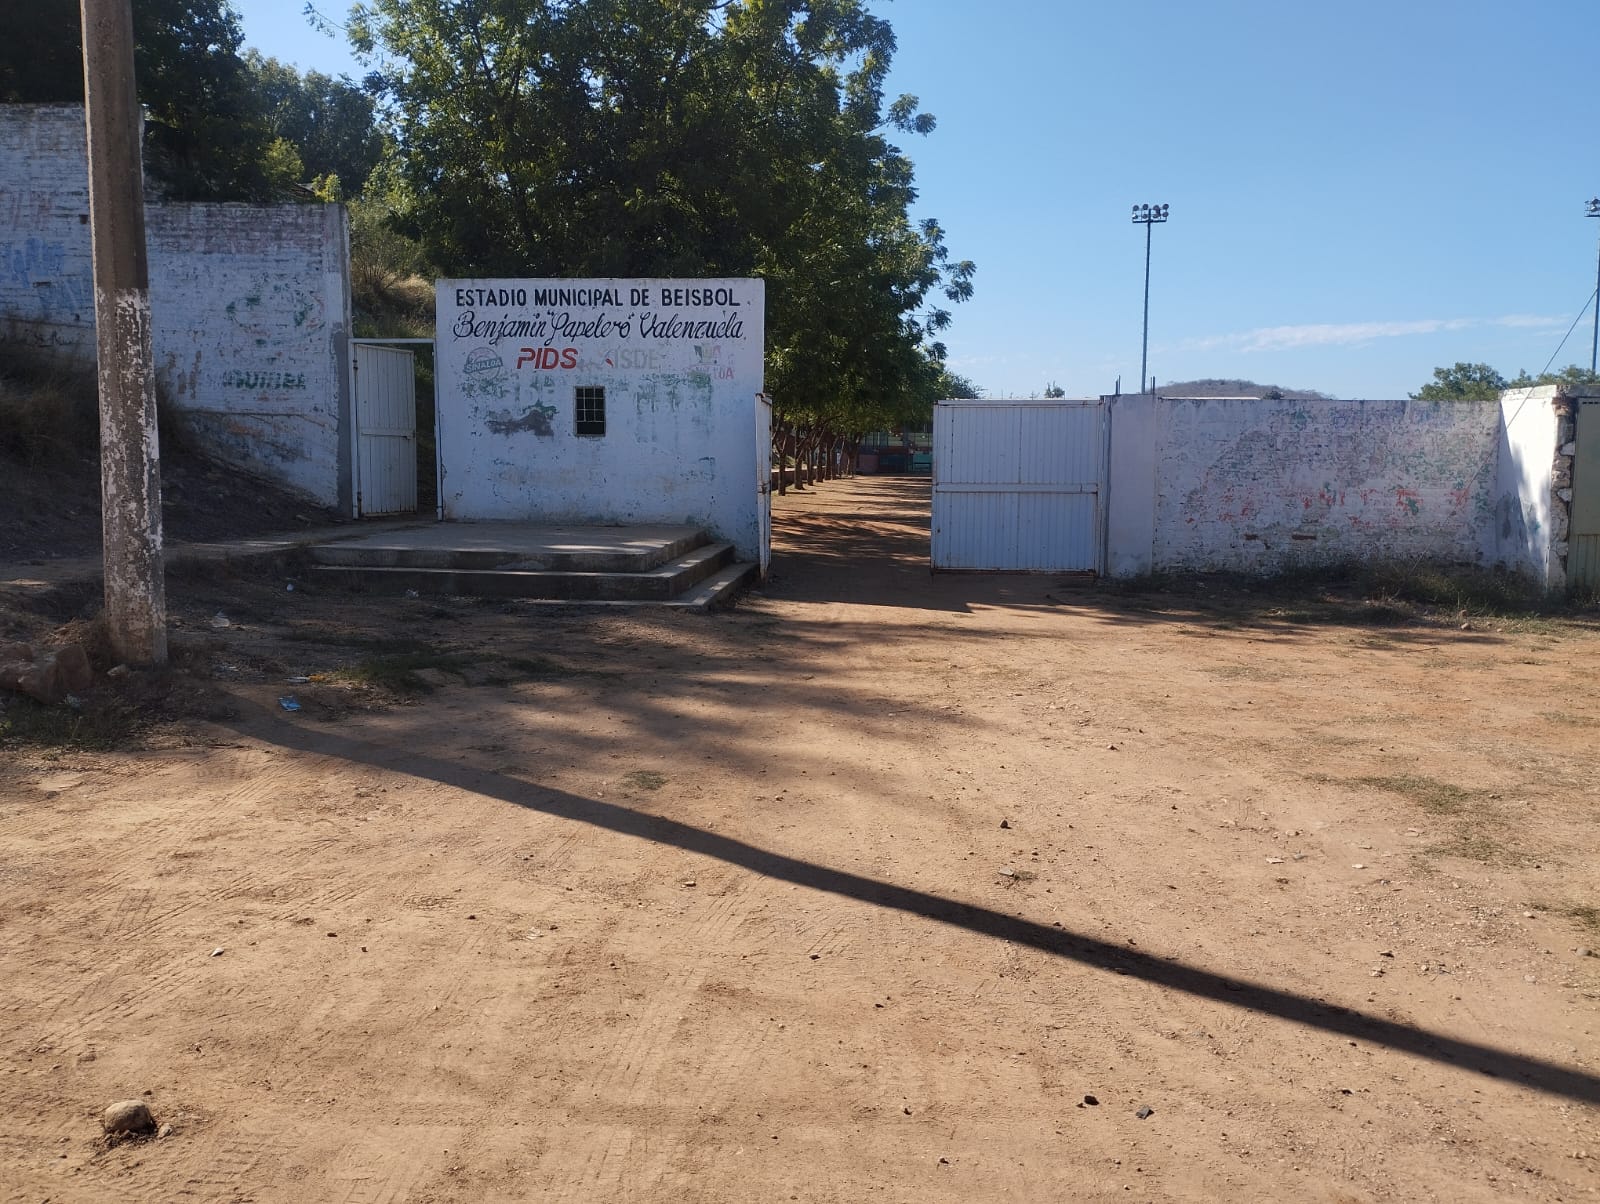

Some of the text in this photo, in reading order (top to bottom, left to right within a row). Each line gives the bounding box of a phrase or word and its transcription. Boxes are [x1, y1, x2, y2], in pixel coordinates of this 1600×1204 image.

[456, 288, 741, 307] ESTADIO MUNICIPAL DE BEISBOL
[639, 311, 744, 339] Valenzuela
[465, 358, 502, 373] SINALOA
[516, 347, 579, 370] PIDS
